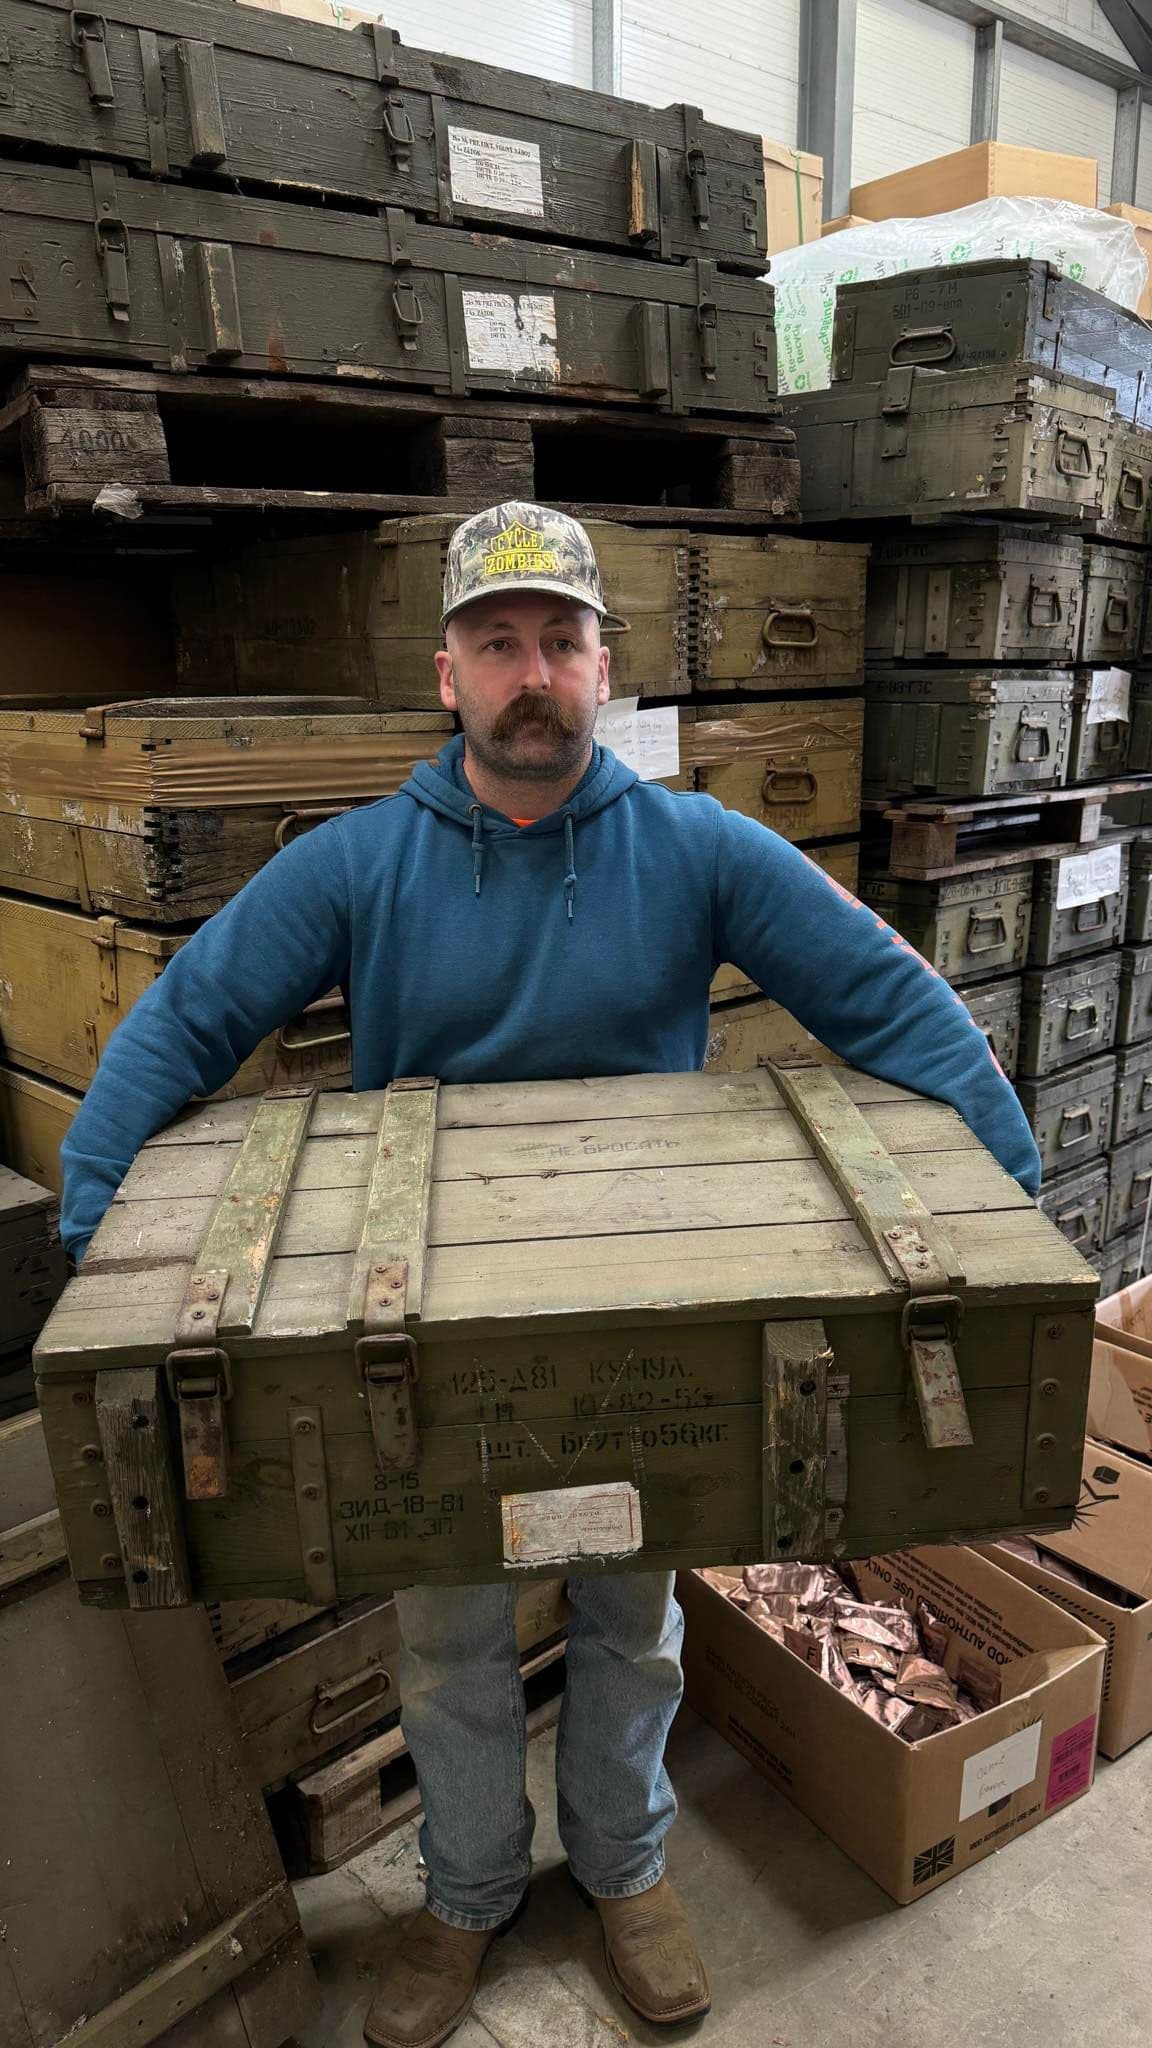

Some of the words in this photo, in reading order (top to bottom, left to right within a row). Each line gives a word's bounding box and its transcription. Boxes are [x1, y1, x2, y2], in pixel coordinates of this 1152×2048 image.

[497, 527, 538, 551] CYCLE
[487, 553, 553, 573] ZOMBIES
[583, 1139, 681, 1156] БРОСАТЬ
[373, 1472, 420, 1491] 8-15
[864, 1559, 892, 1585] ONLY
[892, 1578, 915, 1599] USE
